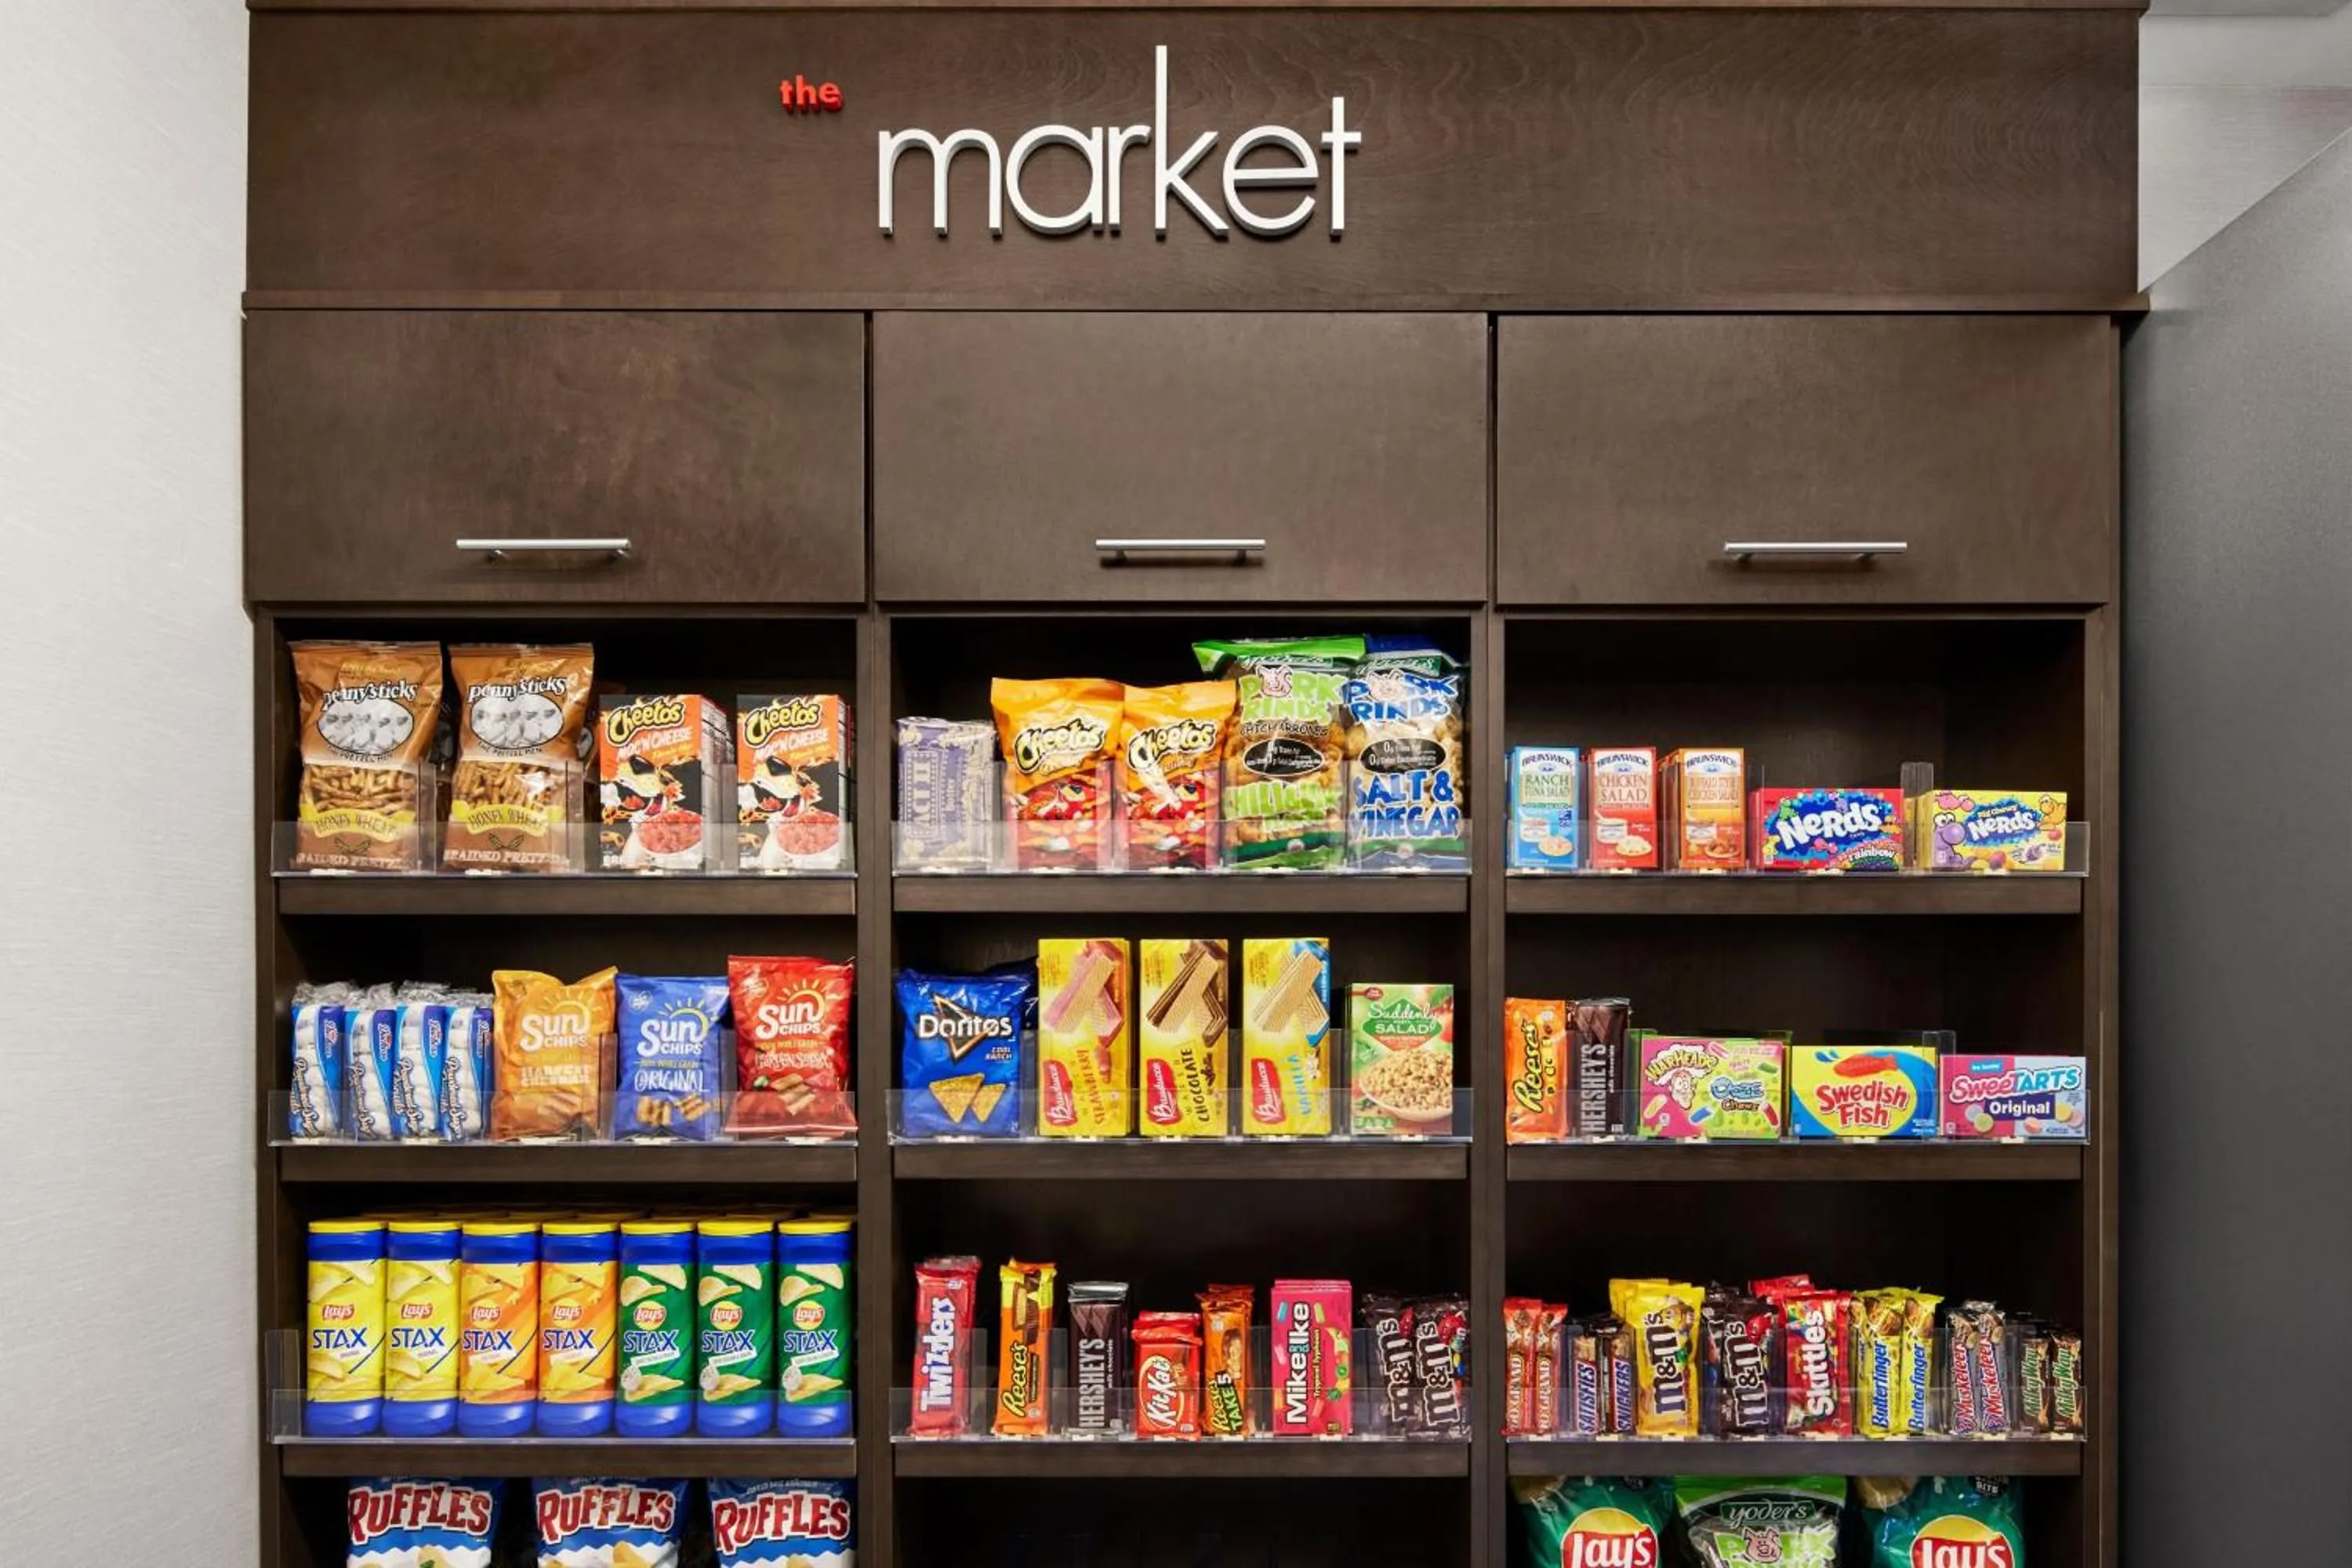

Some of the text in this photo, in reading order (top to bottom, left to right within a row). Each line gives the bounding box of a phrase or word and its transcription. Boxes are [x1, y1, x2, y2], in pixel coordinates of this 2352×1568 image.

[779, 75, 843, 112] the
[878, 45, 1363, 237] market
[607, 697, 685, 746] Cheetos
[744, 698, 822, 748] Cheetos
[1349, 696, 1450, 723] RINDS
[1014, 717, 1105, 773] Cheetos
[1127, 719, 1216, 771] Cheetos
[1597, 754, 1649, 768] BRUNSWICK
[1353, 770, 1428, 809] SALT
[1432, 770, 1455, 803] &
[1526, 774, 1569, 786] RANCH
[1599, 775, 1647, 788] CHICKEN
[1601, 788, 1647, 801] SALAD
[1350, 805, 1461, 840] VINEGAR
[1848, 845, 1895, 862] rainbow
[519, 1014, 589, 1051] Sun
[755, 1001, 825, 1040] Sun
[779, 1023, 822, 1036] CHIPS
[917, 1014, 1013, 1039] Doritos
[1367, 1001, 1441, 1032] Suddenly
[1374, 1023, 1429, 1034] SALAD
[544, 1035, 587, 1049] CHIPS
[637, 1019, 705, 1057] Sun
[661, 1042, 704, 1056] CHIPS
[634, 1069, 710, 1092] ORIGINAL
[1513, 1019, 1544, 1113] Reese's
[1150, 1062, 1176, 1122] Bauducco
[1181, 1047, 1210, 1123] CHOCOLATE
[1254, 1061, 1282, 1122] Bauducco
[1581, 1044, 1606, 1132] HERSHEY'S
[1815, 1080, 1910, 1113] Swedish
[1836, 1103, 1889, 1127] Fish
[1989, 1101, 2050, 1116] Original
[313, 1327, 367, 1349] STAX
[391, 1327, 445, 1349] STAX
[463, 1329, 513, 1350] STAX
[543, 1329, 596, 1350] STAX
[624, 1329, 678, 1352] STAX
[702, 1329, 755, 1352] STAX
[784, 1329, 837, 1352] STAX
[1003, 1341, 1028, 1417] Reese's
[1417, 1322, 1461, 1425] m&m's
[1644, 1312, 1686, 1414] m&m's
[1726, 1322, 1769, 1426] m&m's
[1079, 1338, 1105, 1428] HERSHEY'S
[1615, 1359, 1632, 1432] SNICKERS
[1872, 1341, 1891, 1429] Butterfinger
[1908, 1344, 1928, 1431] Butterfinger
[1217, 1373, 1244, 1431] TAKE 5
[348, 1482, 493, 1546] RUFFLES
[535, 1484, 677, 1545] RUFFLES
[712, 1490, 851, 1555] RUFFLES
